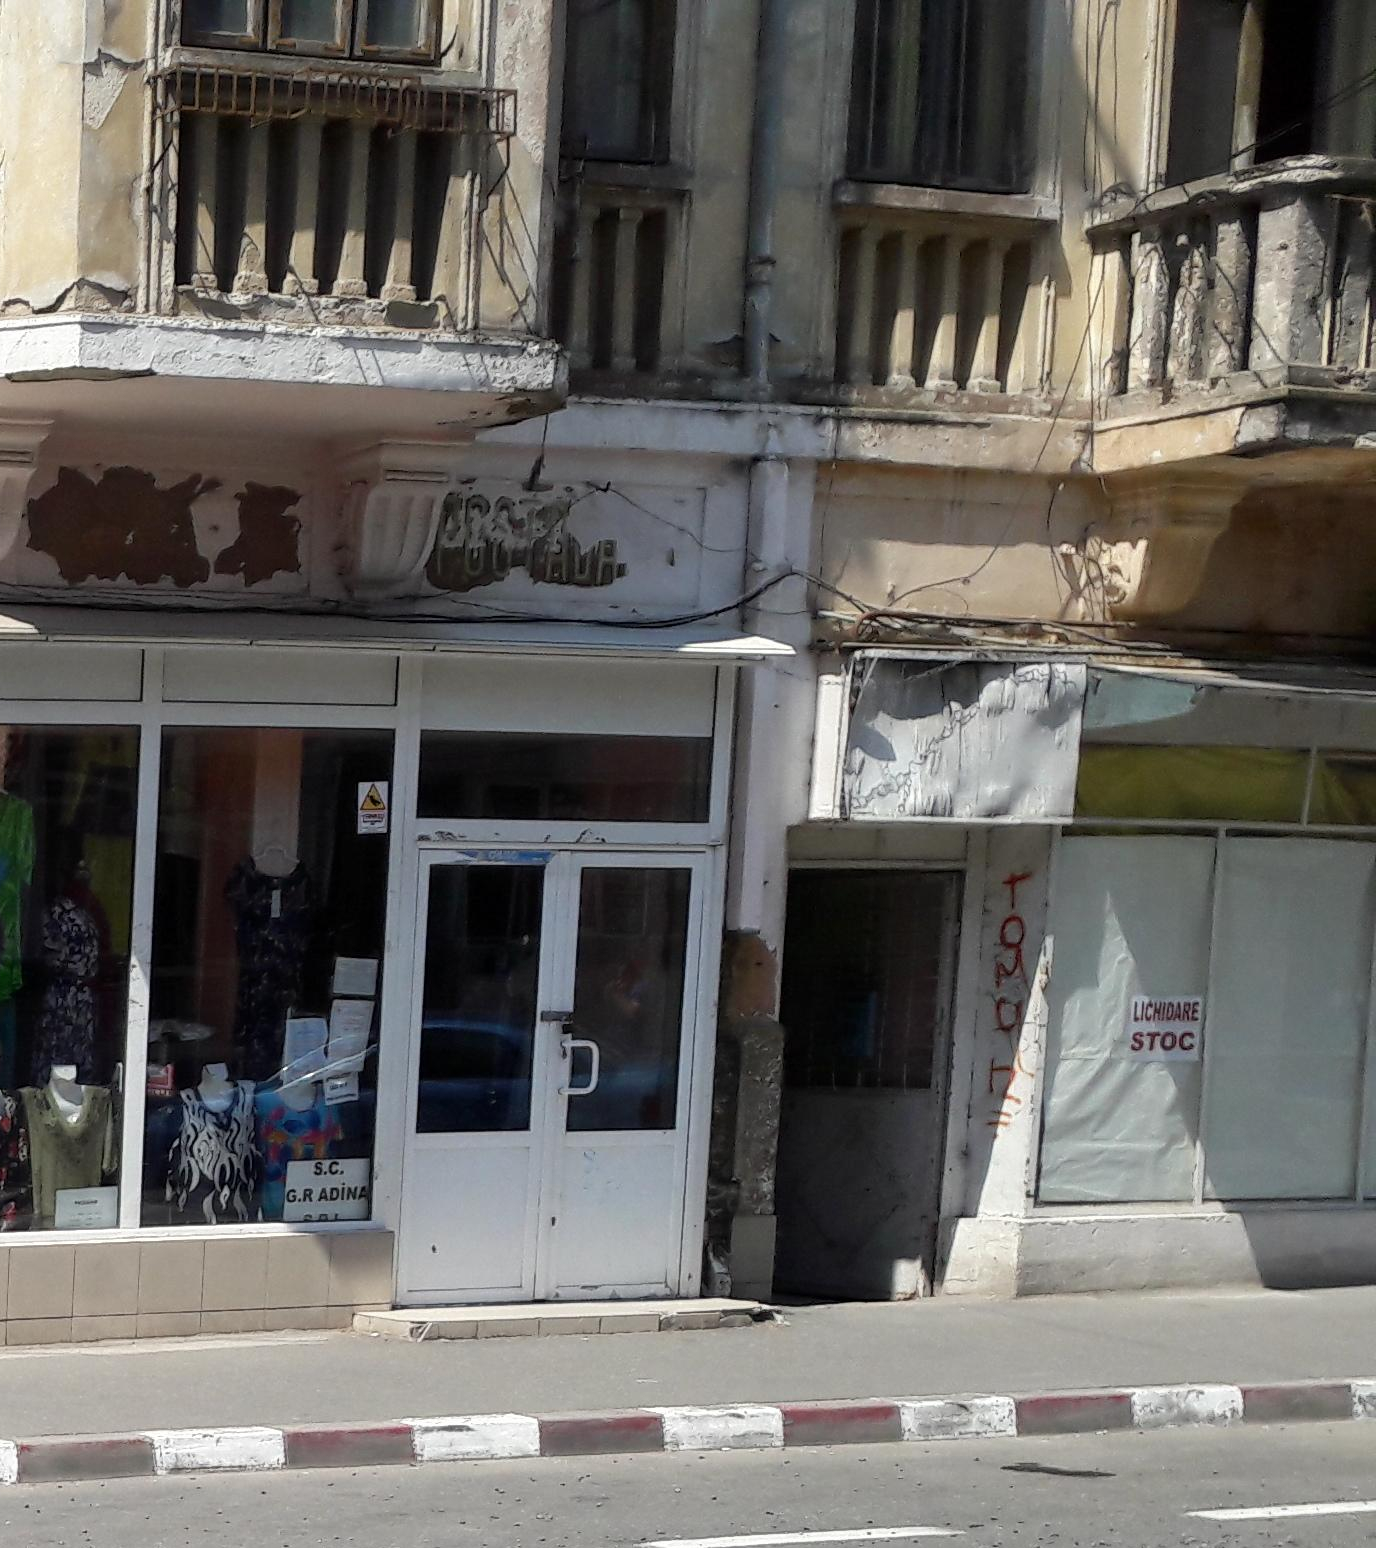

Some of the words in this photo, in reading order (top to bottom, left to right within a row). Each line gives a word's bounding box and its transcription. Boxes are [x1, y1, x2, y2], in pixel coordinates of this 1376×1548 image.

[1133, 1000, 1200, 1022] LICHIDARE
[1130, 1031, 1195, 1051] STOC
[313, 1161, 345, 1176] S.C.
[286, 1188, 313, 1203] G.R
